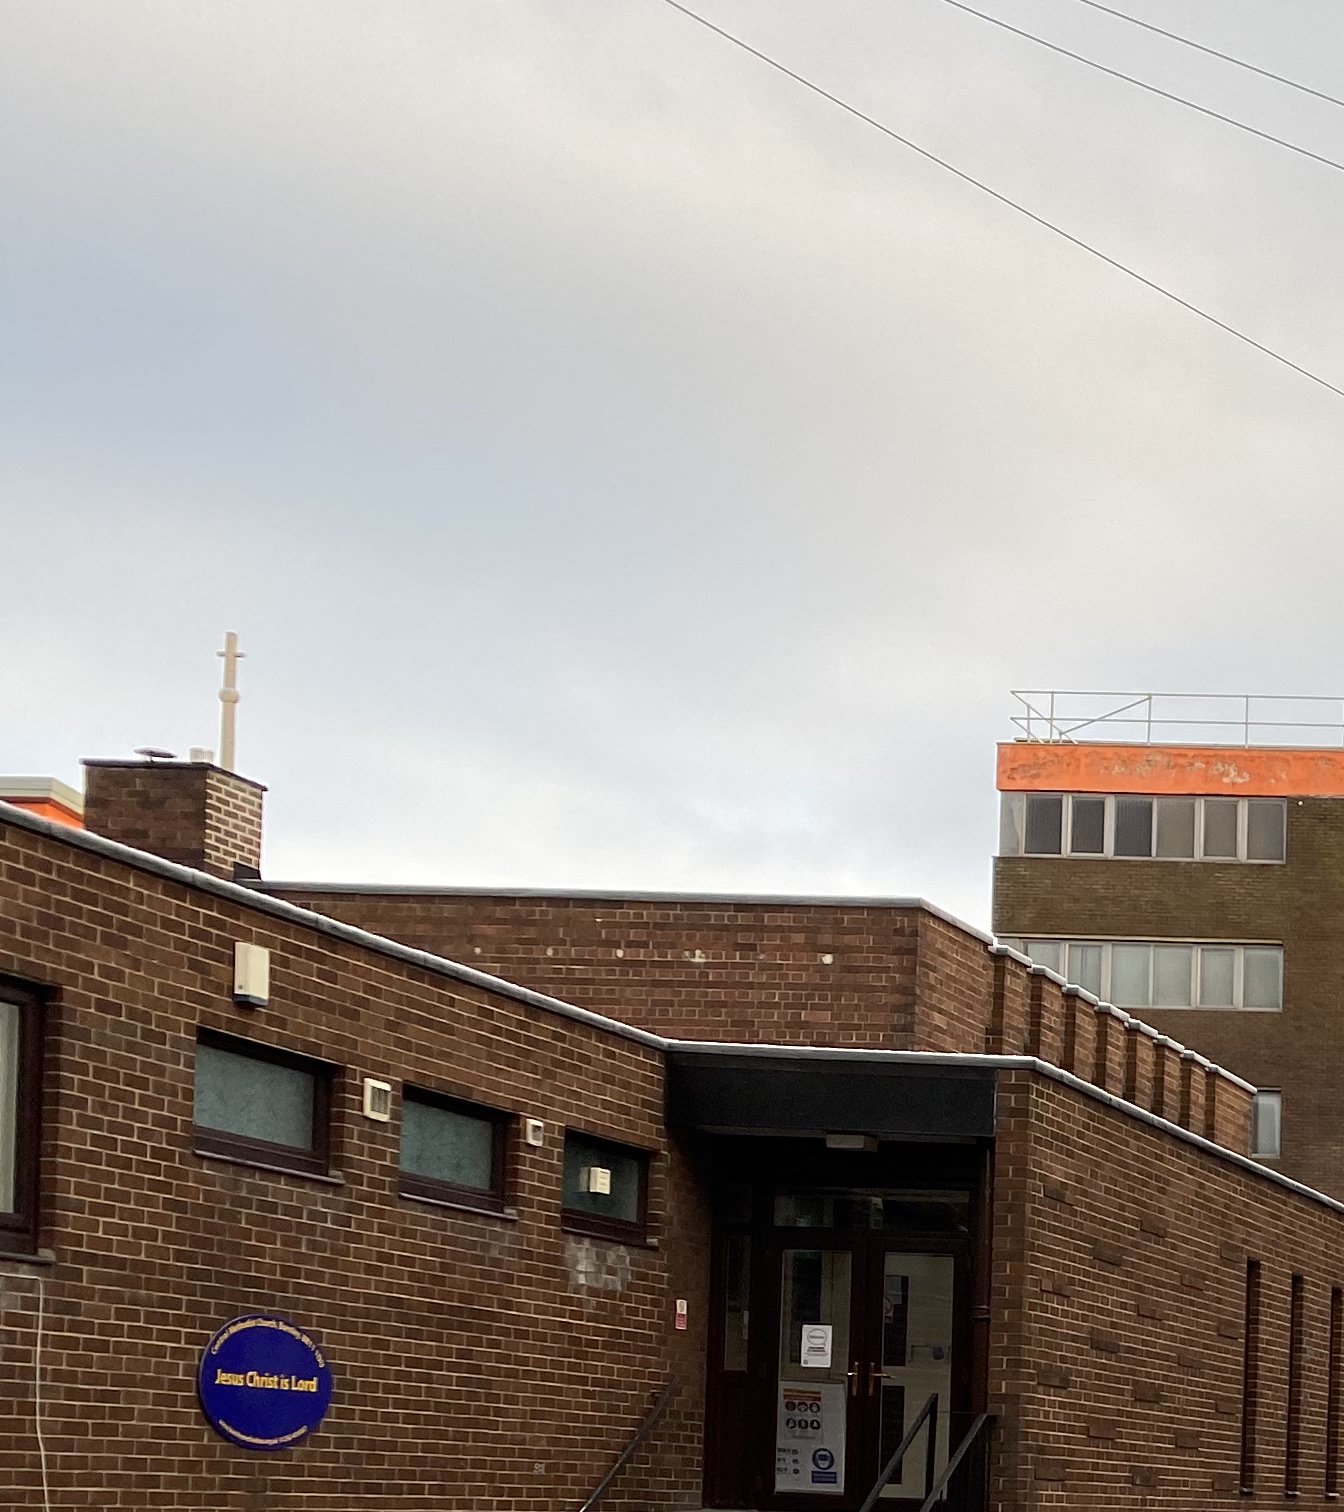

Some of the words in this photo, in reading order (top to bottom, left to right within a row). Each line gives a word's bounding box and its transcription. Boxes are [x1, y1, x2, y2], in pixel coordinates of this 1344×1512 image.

[214, 1368, 244, 1385] Jesus
[246, 1370, 279, 1389] Christ
[280, 1374, 290, 1390] is
[291, 1375, 318, 1392] Lord
